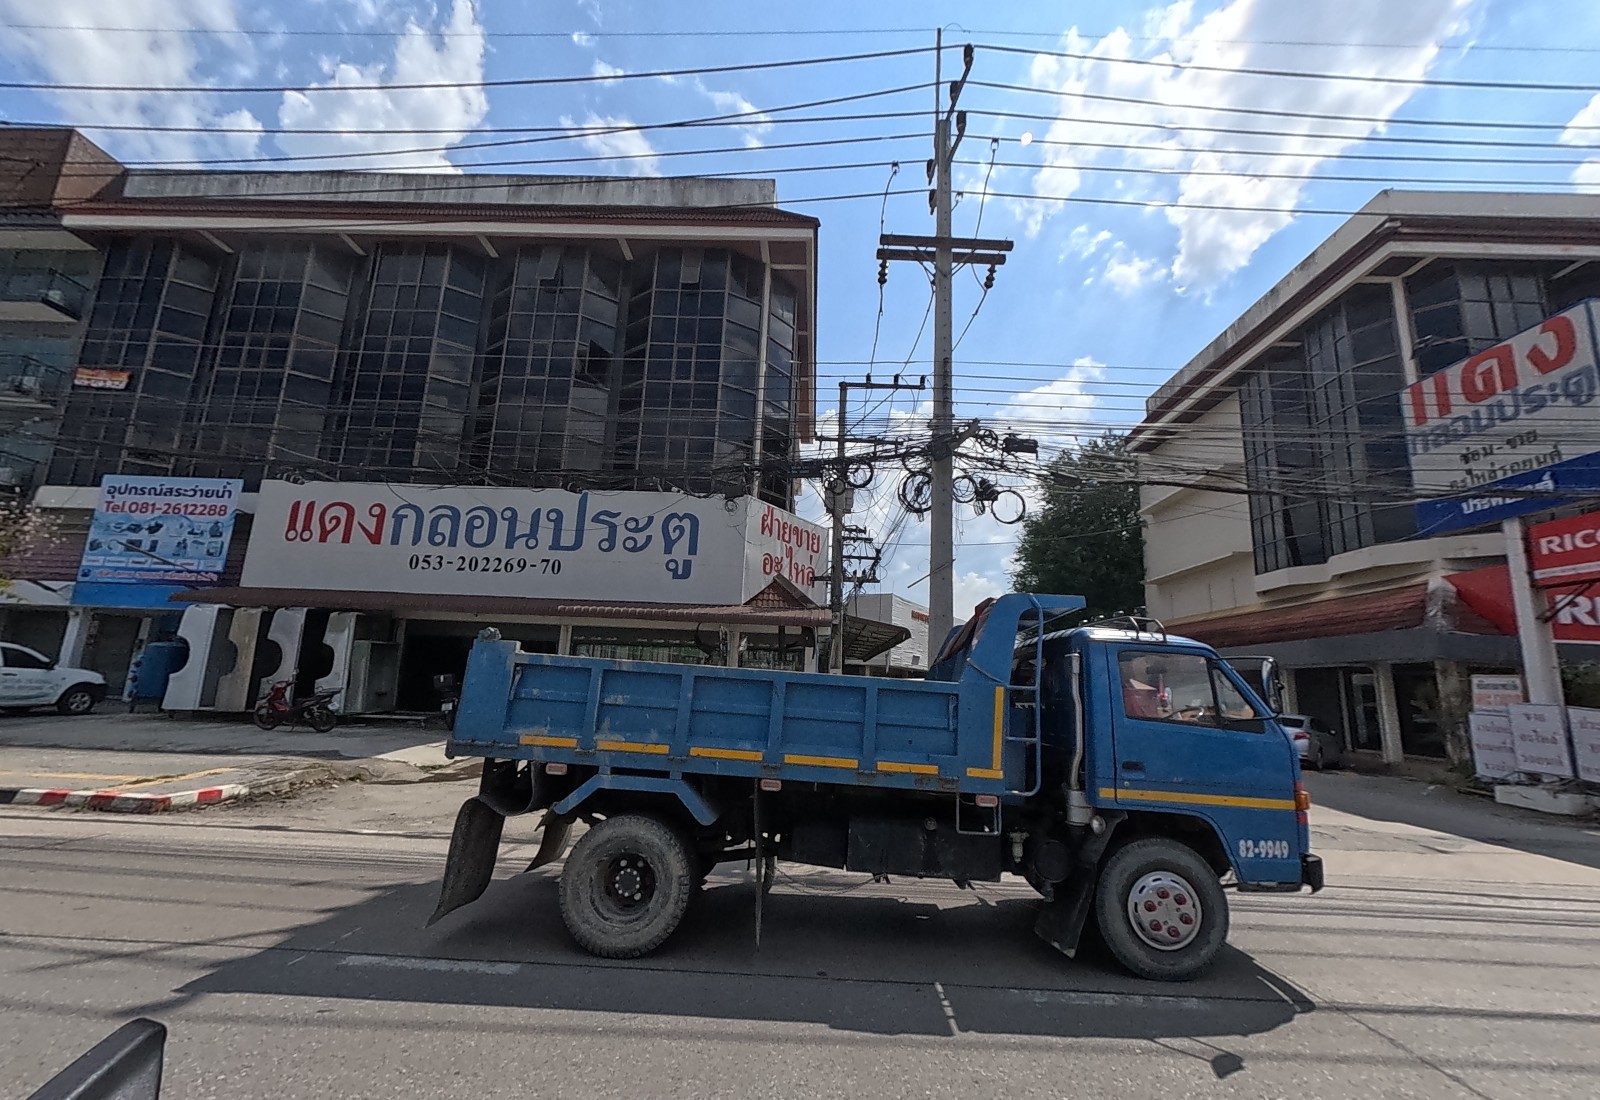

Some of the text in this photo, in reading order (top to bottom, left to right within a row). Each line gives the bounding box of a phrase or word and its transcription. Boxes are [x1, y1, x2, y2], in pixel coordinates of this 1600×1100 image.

[1409, 315, 1576, 426] แดง
[106, 481, 232, 500] อุปกรณ์สระว่ายน้ำ
[104, 501, 228, 517] Tel.081-2612288
[284, 490, 699, 580] แดงกลอนประตู
[760, 505, 821, 554] ฝ่ายขาย
[1539, 529, 1600, 555] RIC
[409, 554, 562, 576] 053-202269-70
[762, 544, 815, 589] อะไหล่
[1238, 838, 1289, 859] 82-9949
